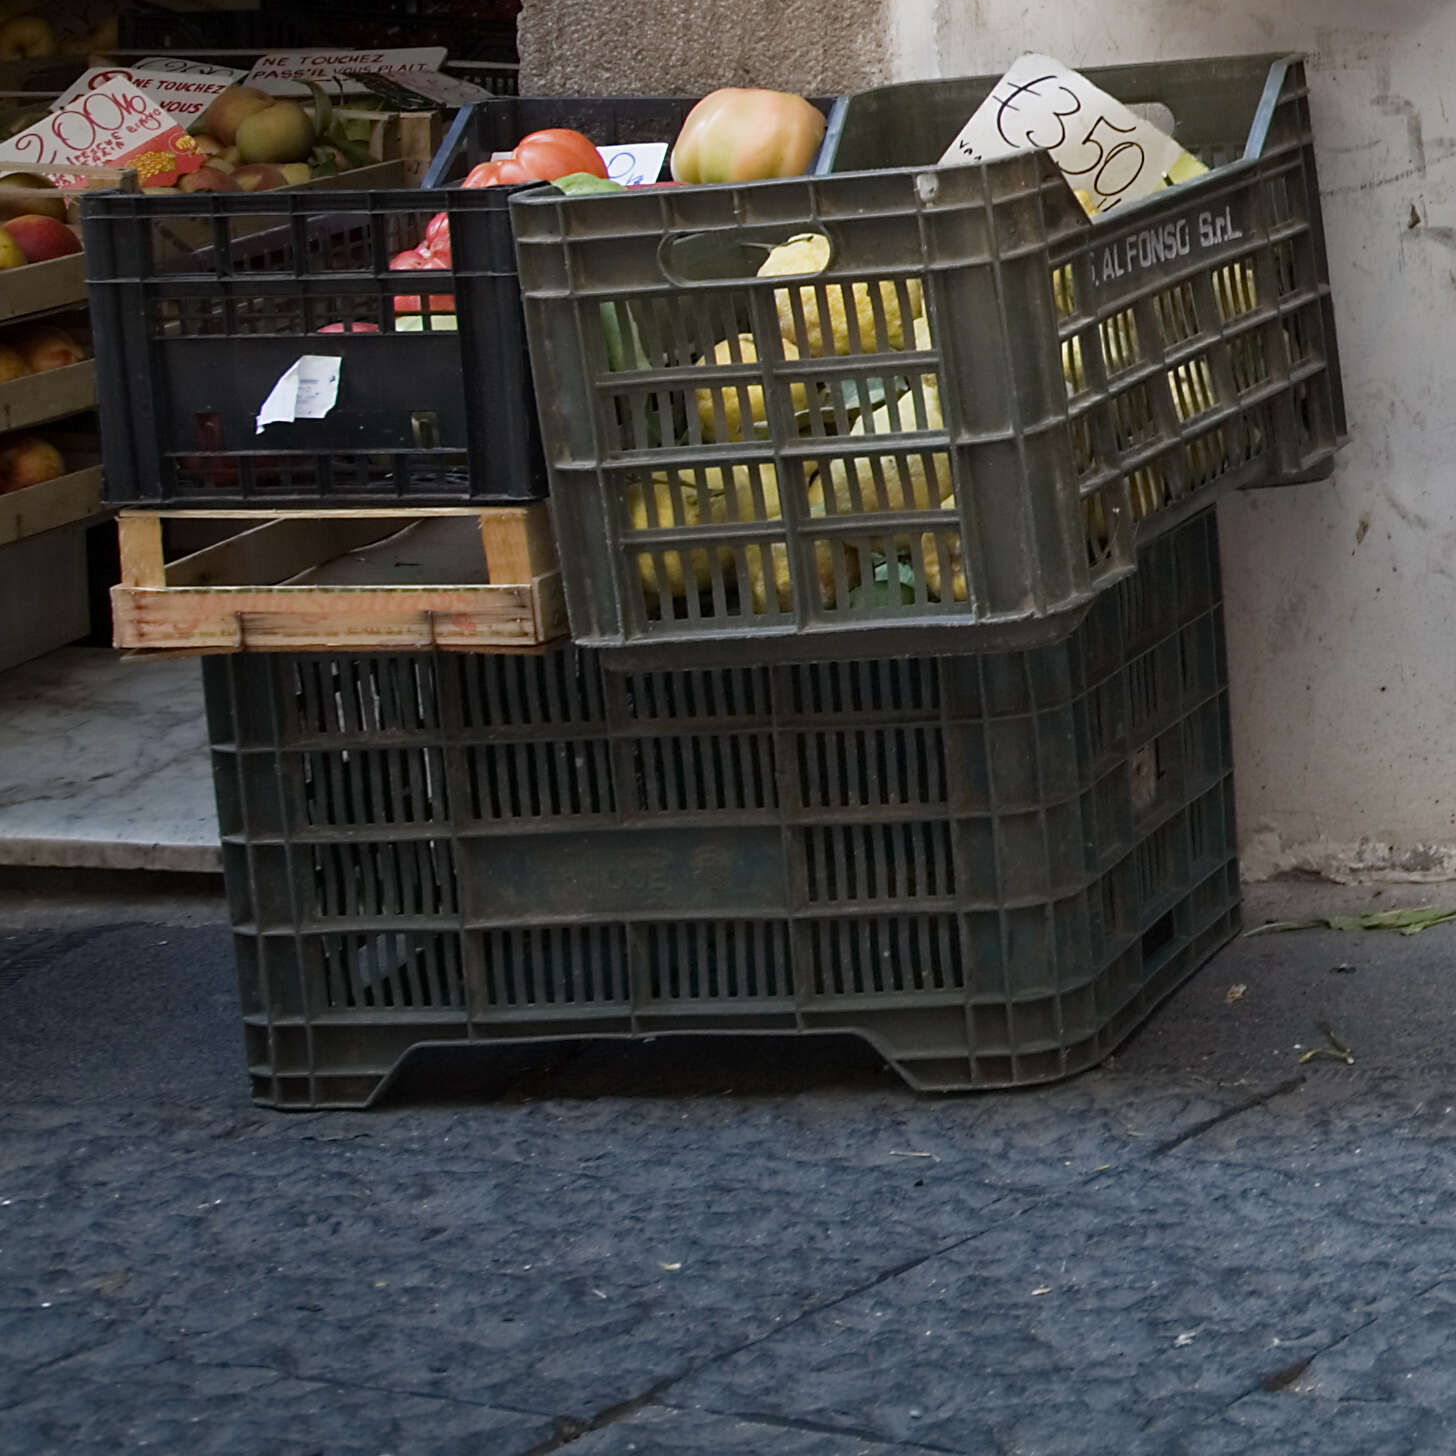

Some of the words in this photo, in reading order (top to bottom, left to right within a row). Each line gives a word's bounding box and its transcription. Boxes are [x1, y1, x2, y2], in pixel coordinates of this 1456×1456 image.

[262, 57, 289, 67] NE
[300, 53, 385, 66] TOUCHEZ
[334, 64, 372, 76] VOUS
[132, 78, 152, 90] NE
[158, 79, 227, 95] TOUCHEZ
[159, 100, 205, 115] VOUS
[1102, 218, 1191, 282] ALFONSO
